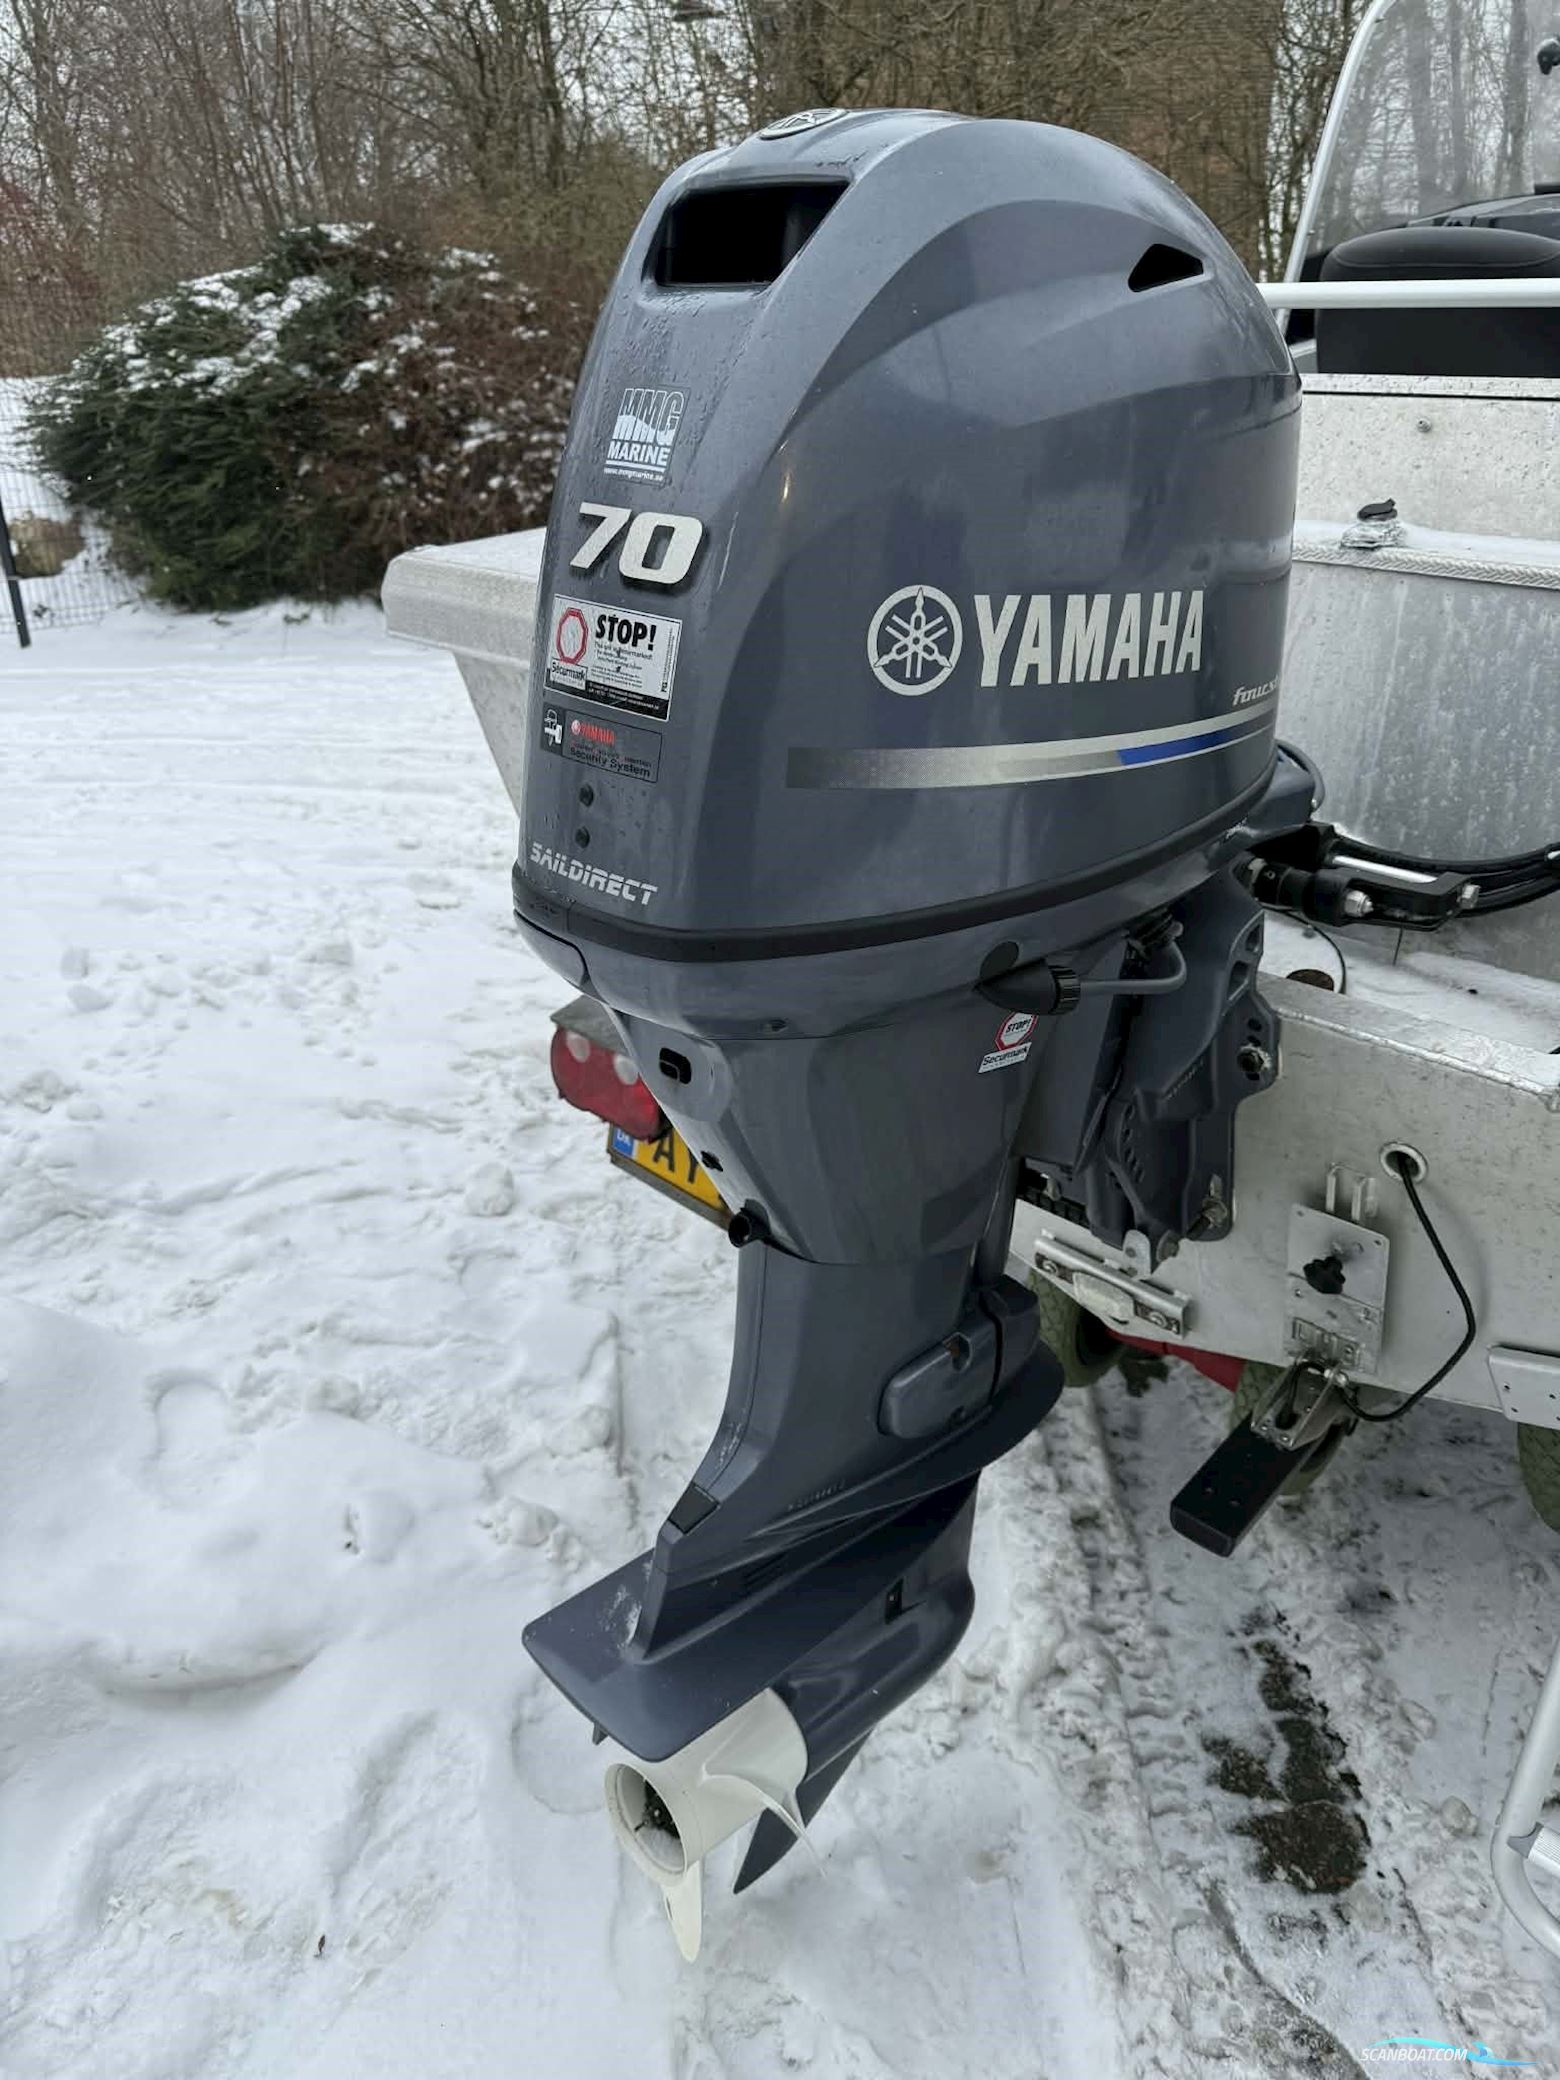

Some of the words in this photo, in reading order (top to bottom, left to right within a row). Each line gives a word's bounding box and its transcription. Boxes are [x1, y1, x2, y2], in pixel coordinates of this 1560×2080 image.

[607, 440, 671, 466] MARINE
[569, 501, 703, 585] 70
[595, 614, 656, 650] STOP!
[974, 590, 1204, 688] YAMAHA
[609, 758, 650, 778] System
[530, 842, 658, 906] SAILDIRECT
